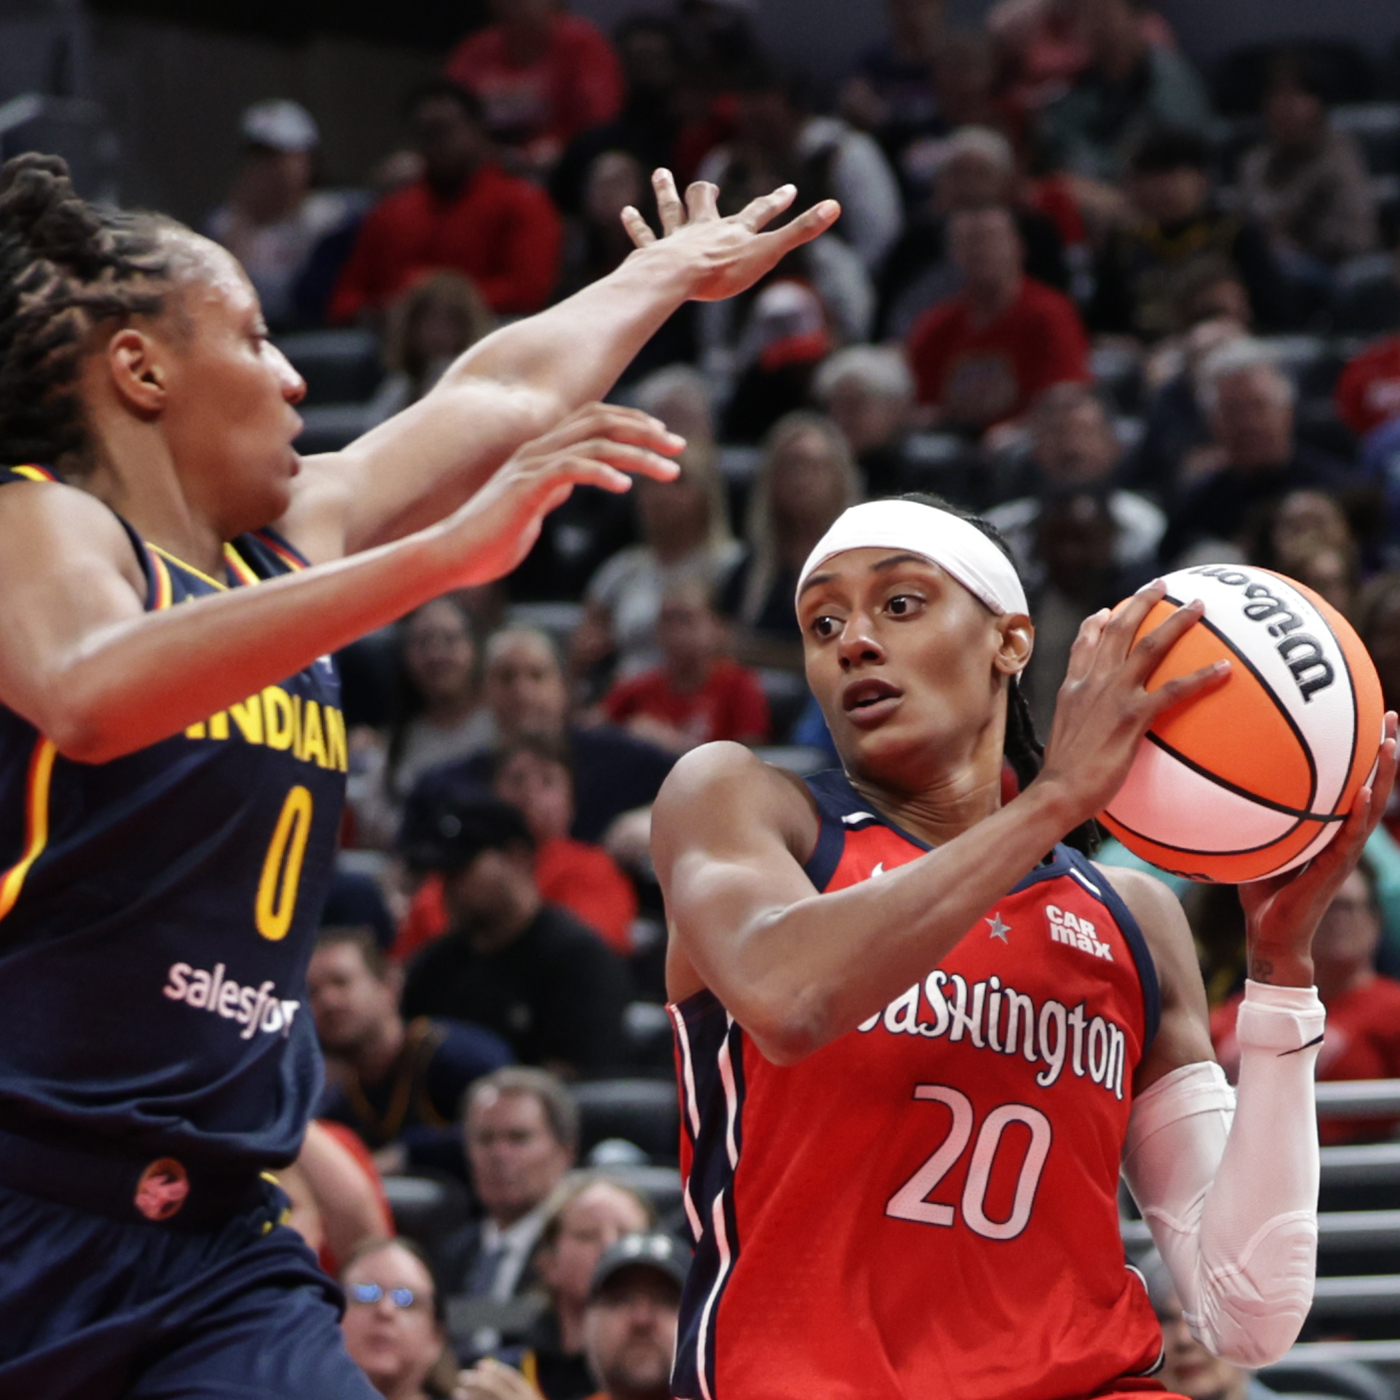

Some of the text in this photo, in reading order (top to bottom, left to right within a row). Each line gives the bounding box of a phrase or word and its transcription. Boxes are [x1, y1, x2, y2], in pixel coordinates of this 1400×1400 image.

[1188, 566, 1334, 704] Wilson
[255, 786, 312, 941] 0
[1046, 904, 1098, 939] CAR
[1050, 922, 1114, 962] max
[885, 1083, 1054, 1241] 20
